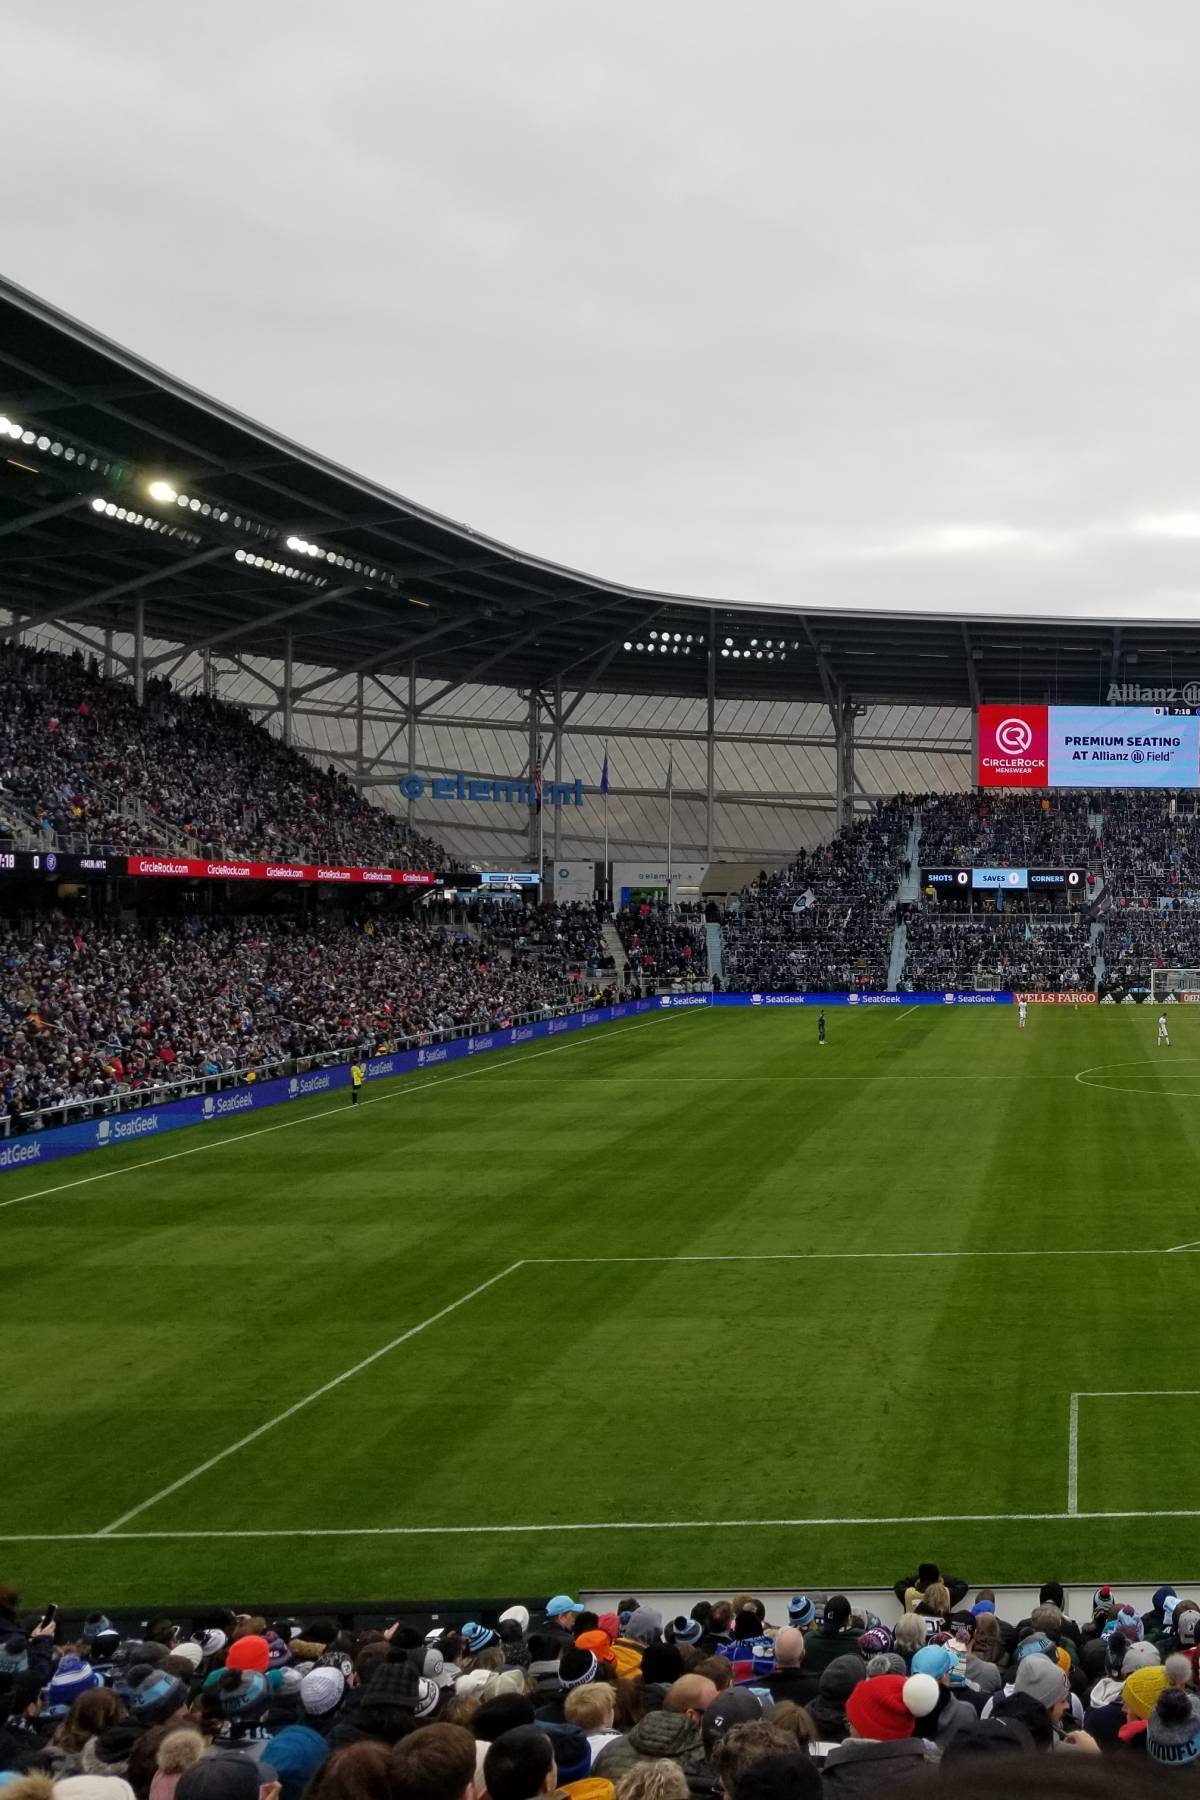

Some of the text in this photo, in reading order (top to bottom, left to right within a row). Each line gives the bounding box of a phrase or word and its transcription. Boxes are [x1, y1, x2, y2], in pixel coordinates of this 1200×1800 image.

[1106, 683, 1179, 702] Allianz
[1065, 736, 1181, 747] PREMIUM SEATING
[1072, 751, 1088, 760] AT
[1091, 751, 1129, 761] Allianz
[33, 855, 40, 869] 0
[139, 861, 189, 874] CircleRock.com
[207, 863, 250, 876] CircleRock.com
[266, 867, 304, 878] CircleRock.com
[957, 872, 968, 884] 0
[1008, 872, 1020, 884] 0
[1068, 872, 1079, 884] 0
[673, 996, 708, 1005] SeatGeek
[765, 995, 805, 1003] SeatGeek
[862, 994, 900, 1003] SeatGeek
[958, 994, 996, 1002] SeatGeek
[1016, 993, 1096, 1003] WELLS FARGO
[425, 1048, 448, 1062] SeatGeek
[368, 1061, 394, 1076] SeatGeek
[300, 1074, 330, 1093] SeatGeek
[217, 1090, 253, 1114] SeatGeek
[114, 1113, 159, 1139] SeatGeek
